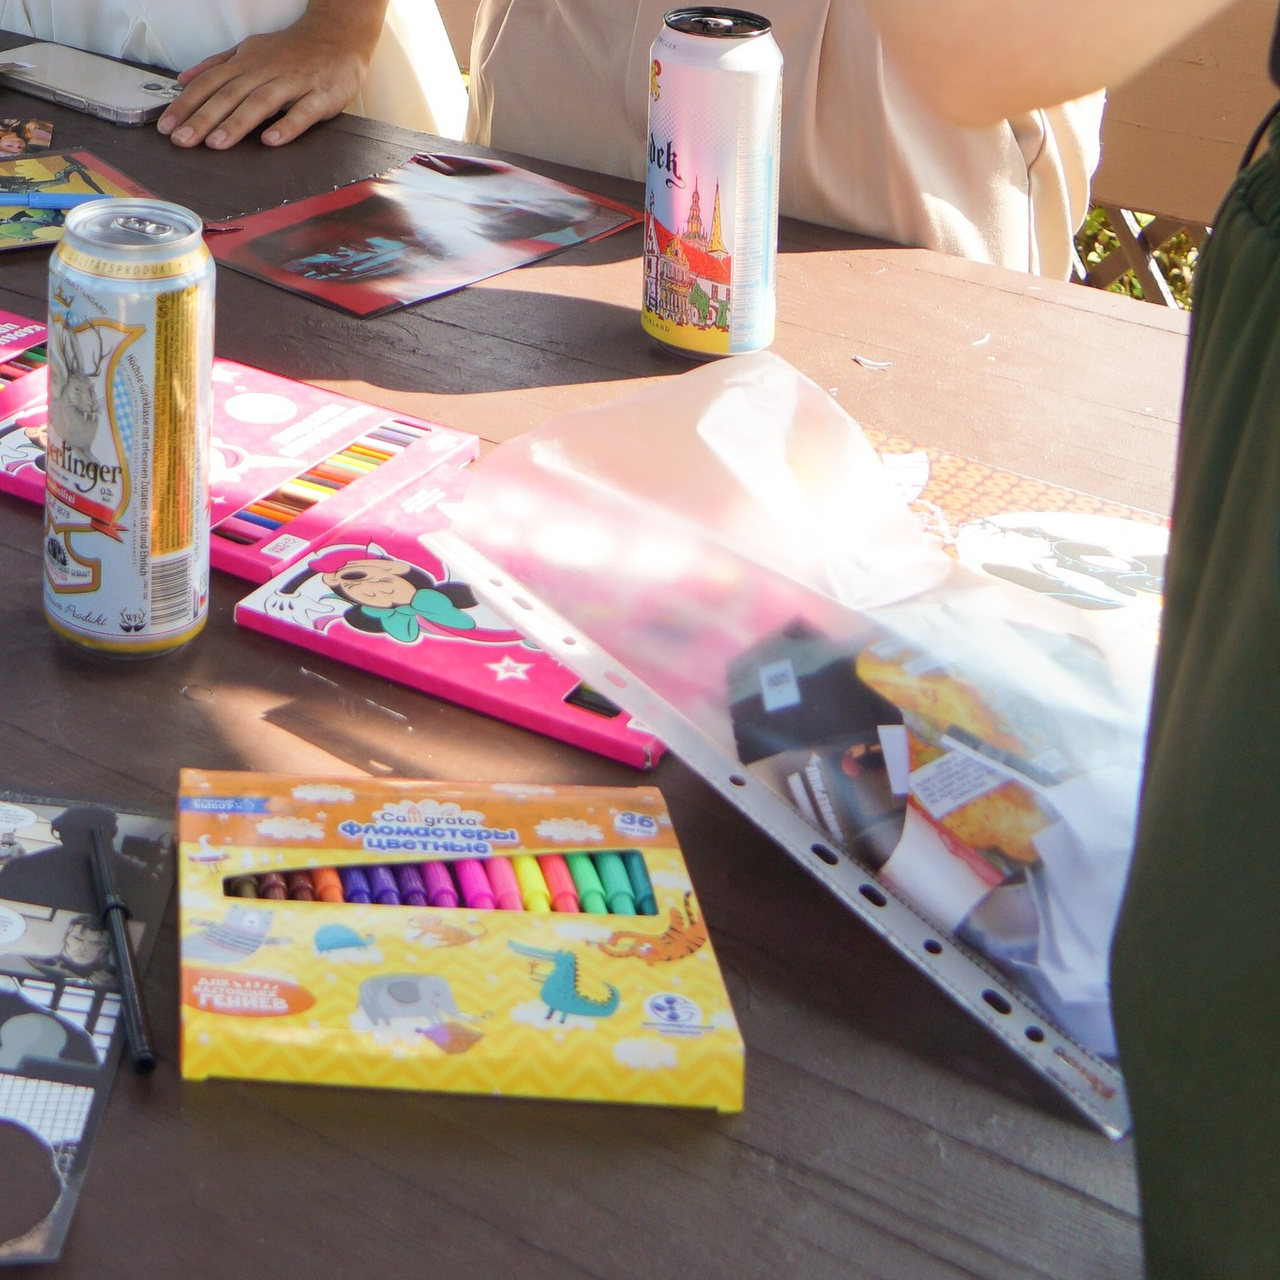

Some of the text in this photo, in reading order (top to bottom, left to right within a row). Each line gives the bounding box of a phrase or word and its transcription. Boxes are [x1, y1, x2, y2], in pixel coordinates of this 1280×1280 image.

[140, 476, 150, 510] Zutaten
[139, 516, 150, 533] Echt
[139, 534, 149, 549] und
[139, 550, 148, 577] Ehrlich
[620, 811, 655, 828] 36
[198, 992, 289, 1011] ГЕНИЕВ
